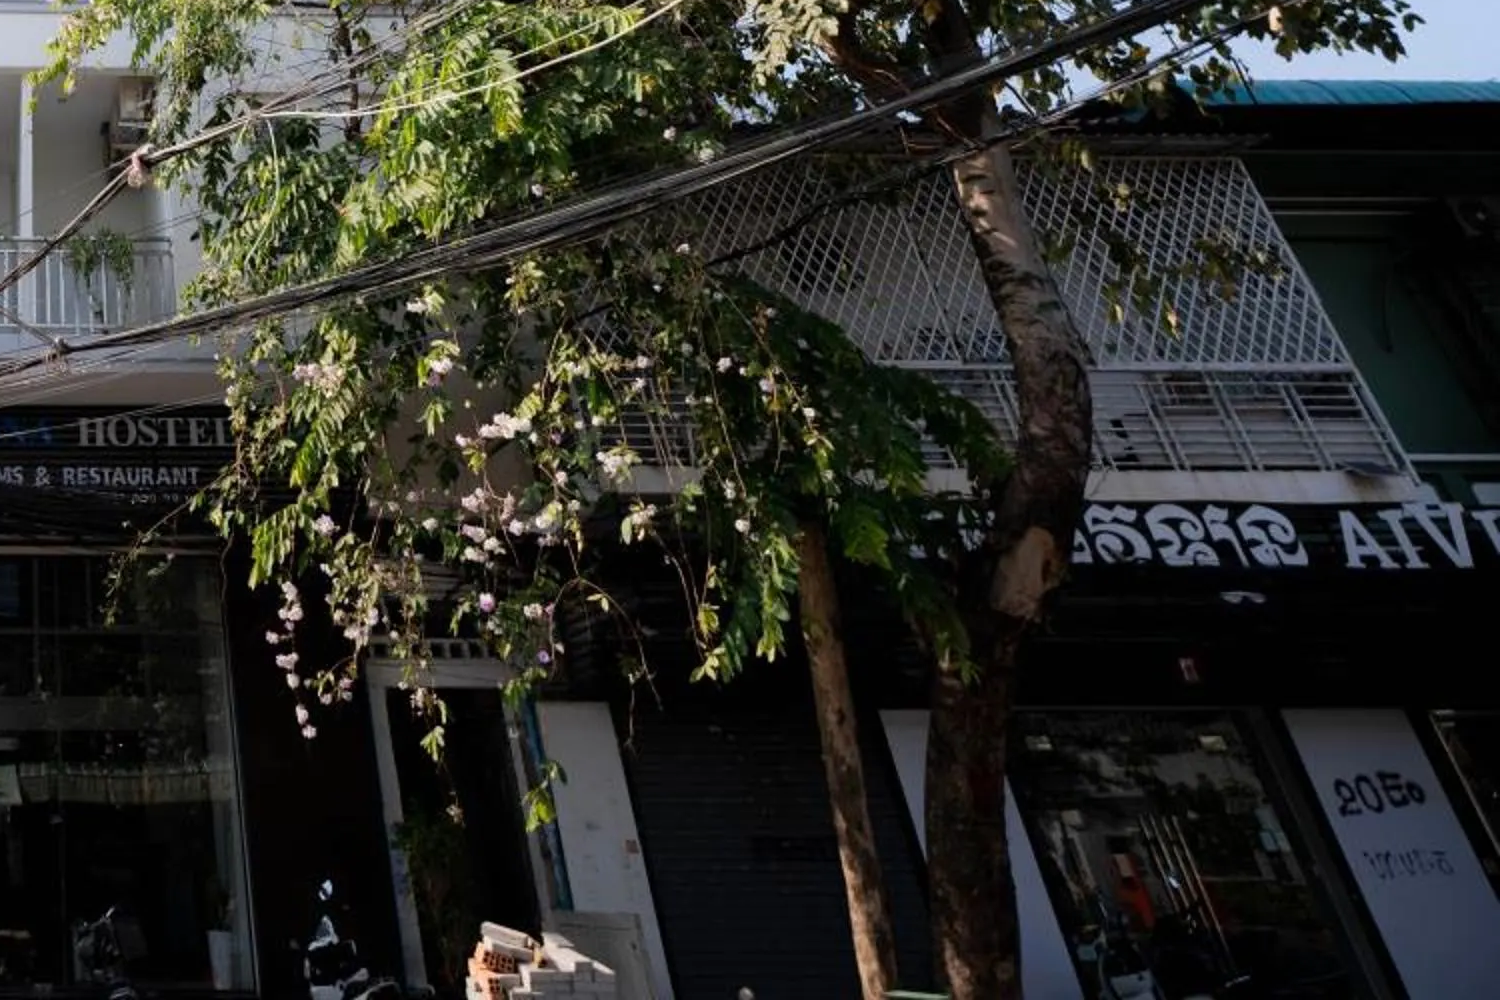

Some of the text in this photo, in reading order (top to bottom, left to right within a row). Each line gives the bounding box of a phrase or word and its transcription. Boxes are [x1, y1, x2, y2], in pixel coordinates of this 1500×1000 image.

[78, 414, 235, 448] HOSTEL
[36, 466, 51, 486] &
[63, 465, 200, 486] RESTAURANT
